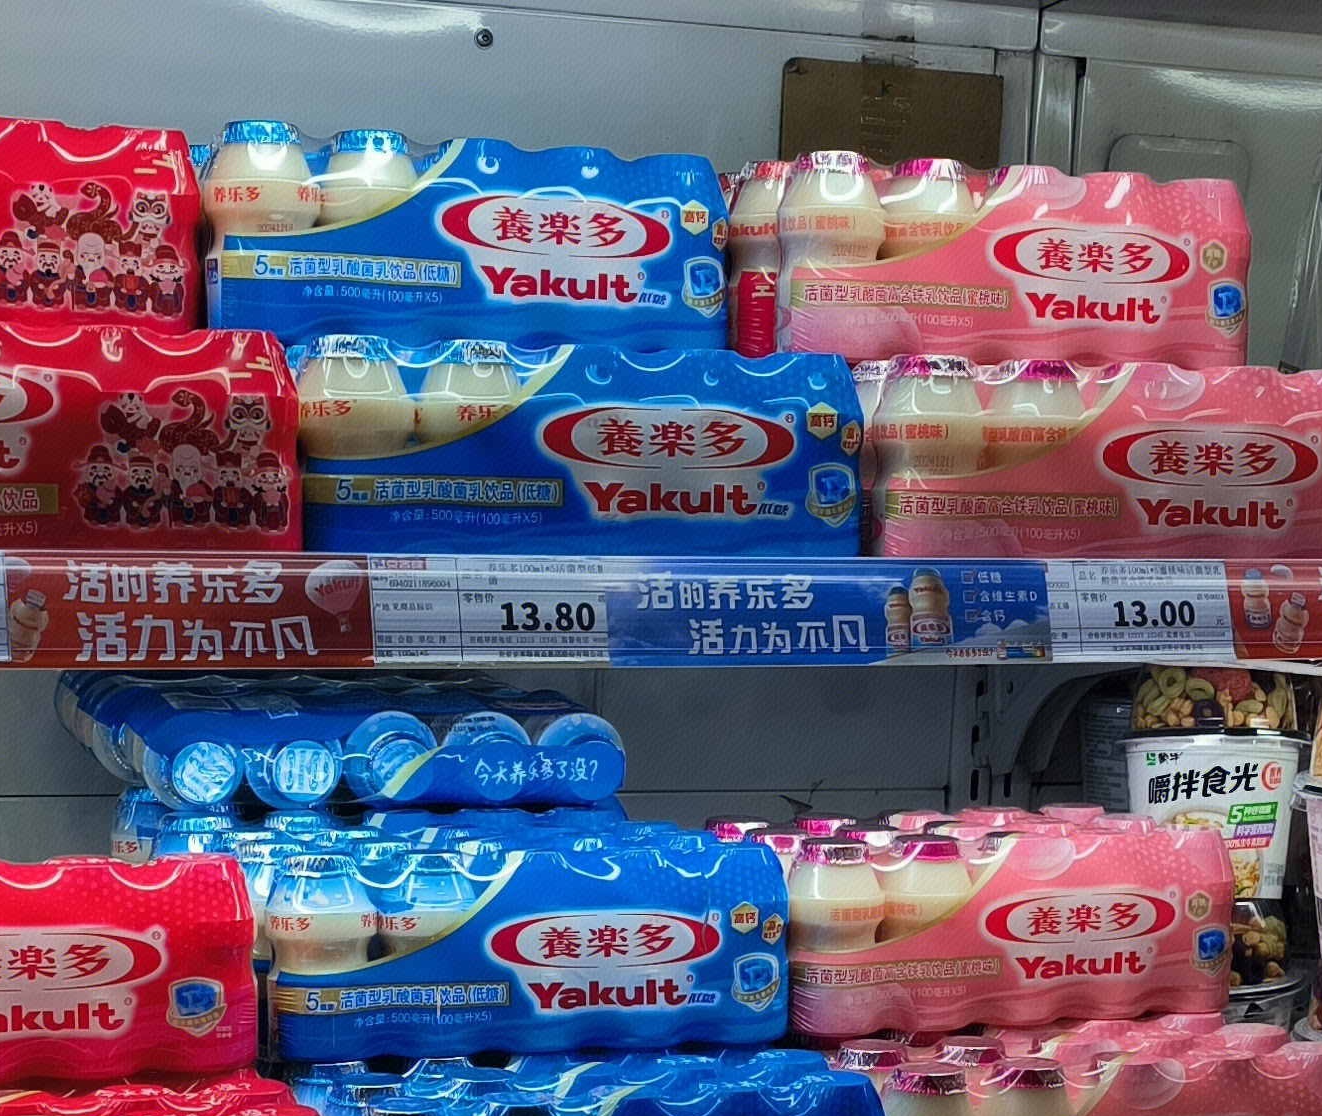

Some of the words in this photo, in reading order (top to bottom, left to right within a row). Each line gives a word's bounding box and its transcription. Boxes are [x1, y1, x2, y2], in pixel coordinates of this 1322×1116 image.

[213, 186, 260, 202] 养乐多
[480, 265, 638, 303] Yakult
[1025, 291, 1161, 325] Yakult
[584, 480, 757, 514] Yakult
[1136, 496, 1287, 530] Yakult
[64, 559, 283, 605] 活的养乐多
[637, 574, 815, 610] 活的养乐多
[977, 570, 1002, 585] 低糖
[462, 593, 494, 603] 零售价
[978, 589, 1038, 604] 含维生素D
[1080, 593, 1107, 602] 零售价
[1113, 600, 1195, 627] 13.00
[500, 601, 595, 631] 13.80
[977, 609, 1005, 624] 含钙
[76, 612, 319, 663] 活力为不凡
[688, 614, 871, 656] 活力为不凡
[1148, 765, 1258, 804] 嚼拌食光
[1015, 950, 1147, 982] Yakult
[527, 978, 687, 1014] Yakult
